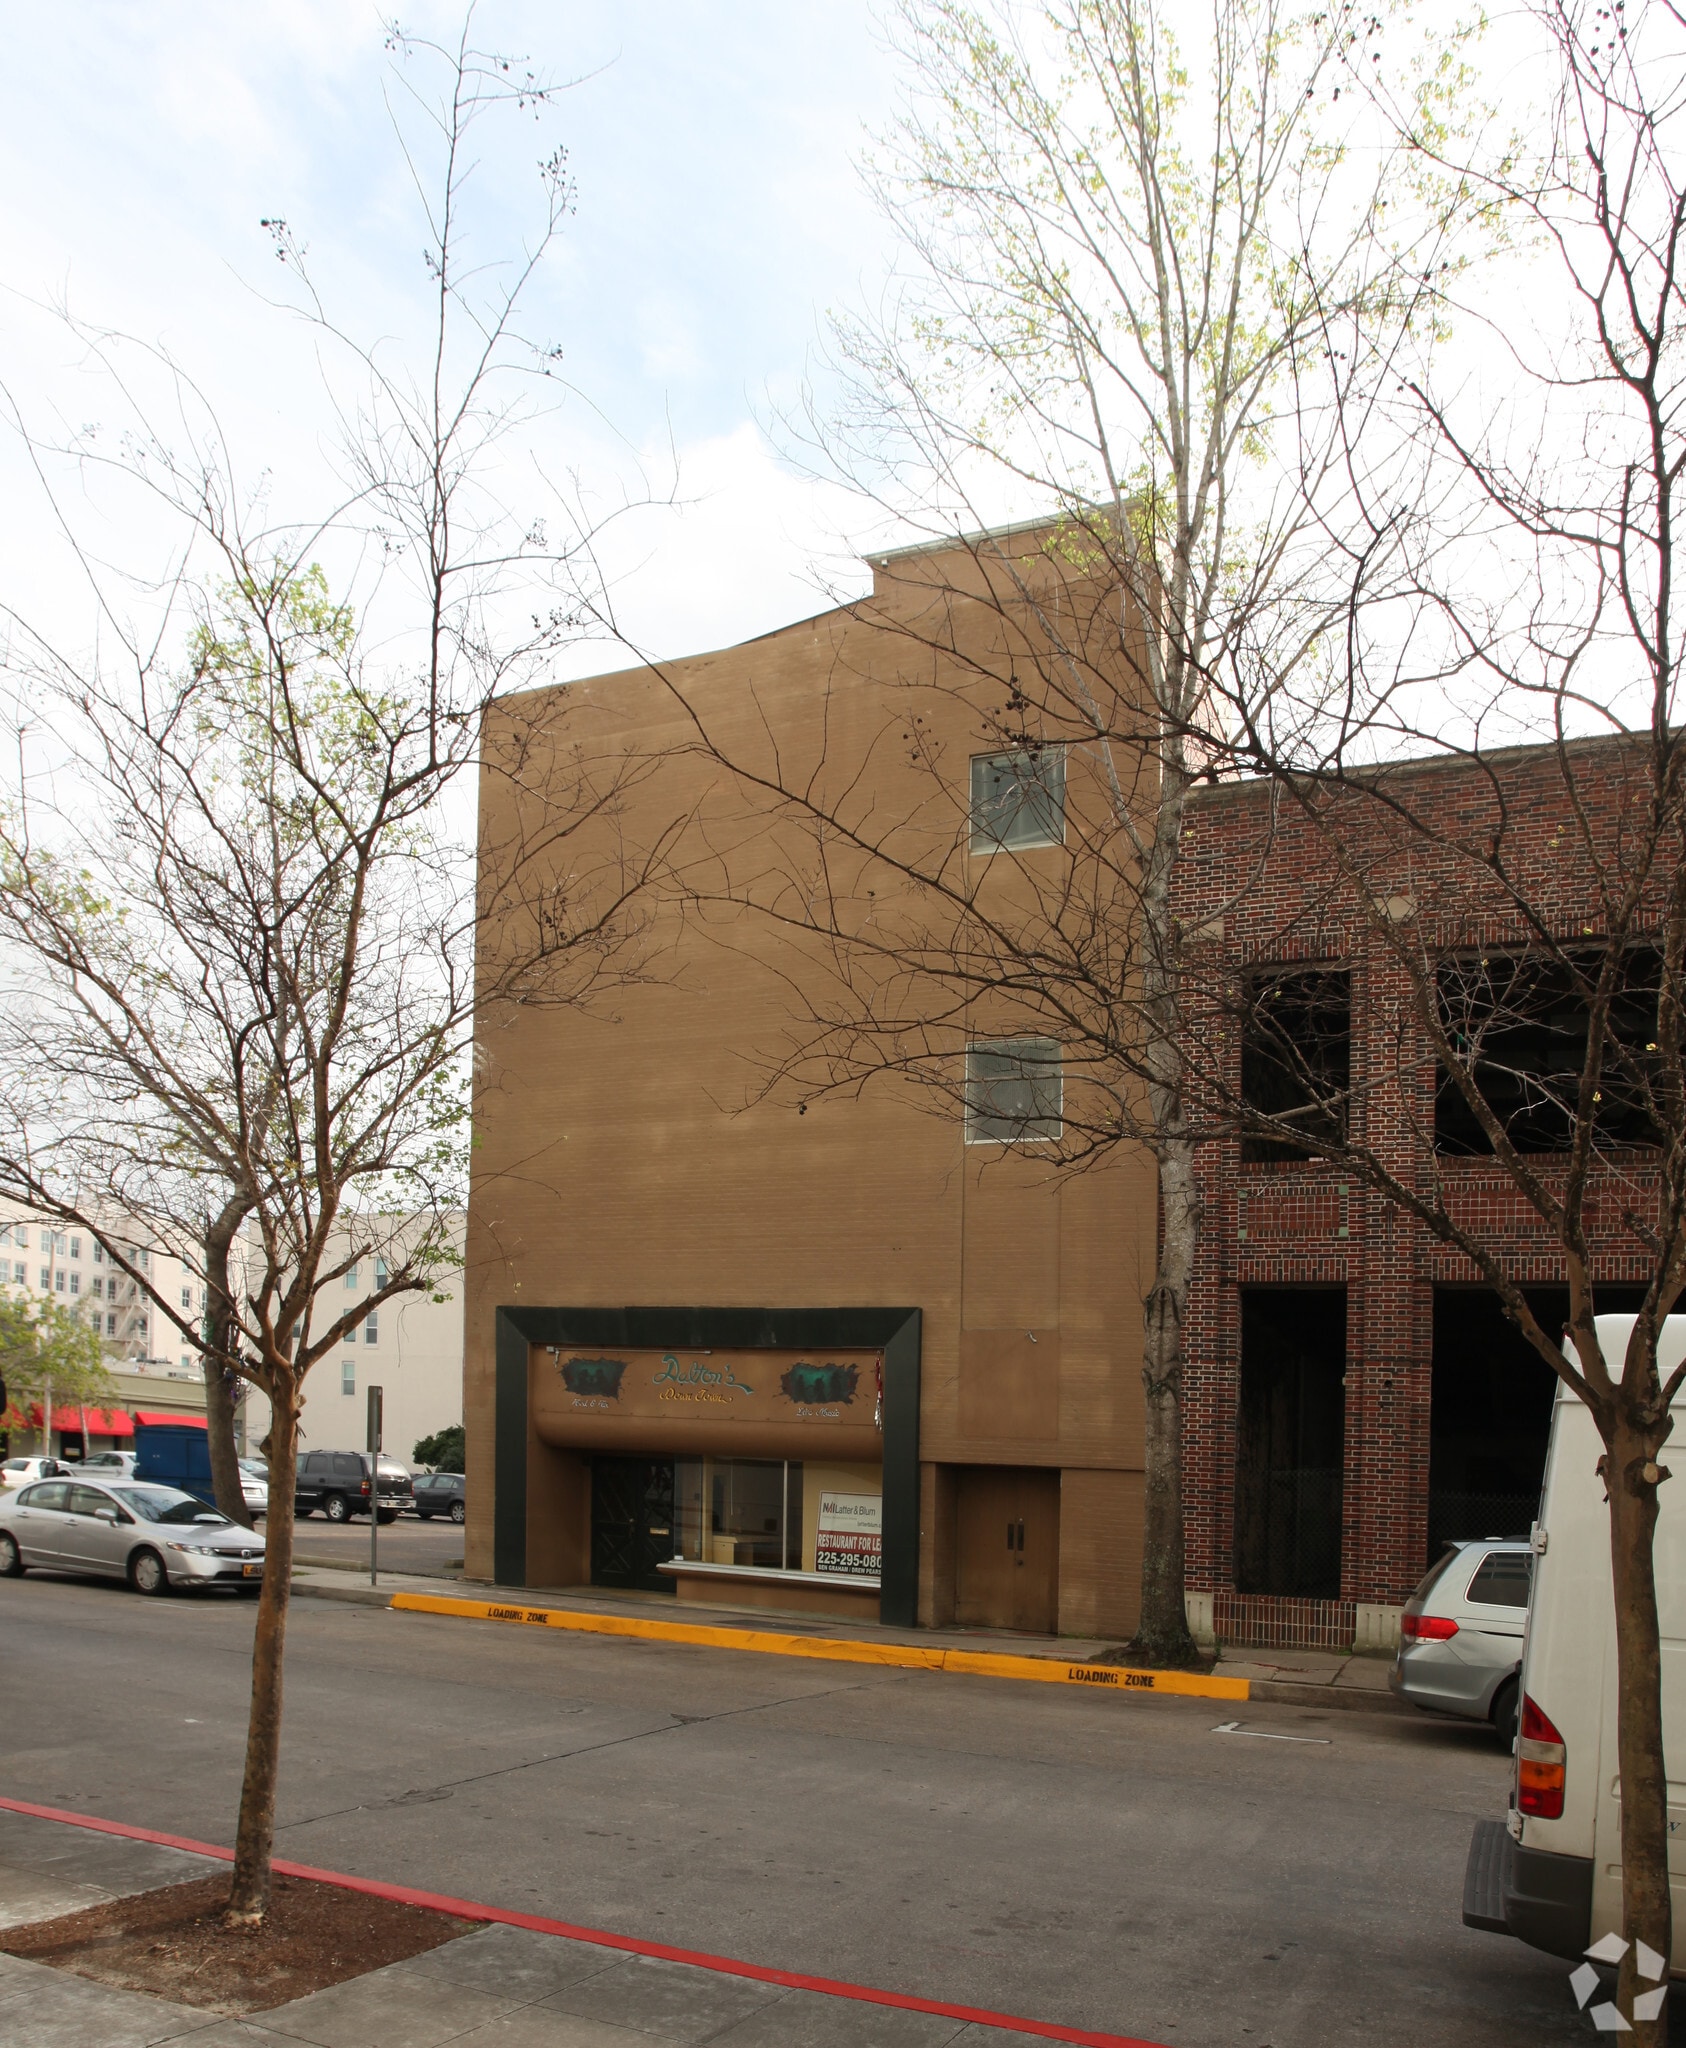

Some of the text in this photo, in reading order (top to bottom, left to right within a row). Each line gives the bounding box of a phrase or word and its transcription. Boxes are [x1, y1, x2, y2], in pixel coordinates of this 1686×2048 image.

[652, 1353, 754, 1395] Dalton's
[859, 1506, 876, 1517] Blum
[817, 1533, 882, 1552] RESTAURANT FOR LE
[487, 1607, 549, 1624] LOADING ZONE
[1068, 1668, 1155, 1688] LOADING ZONE
